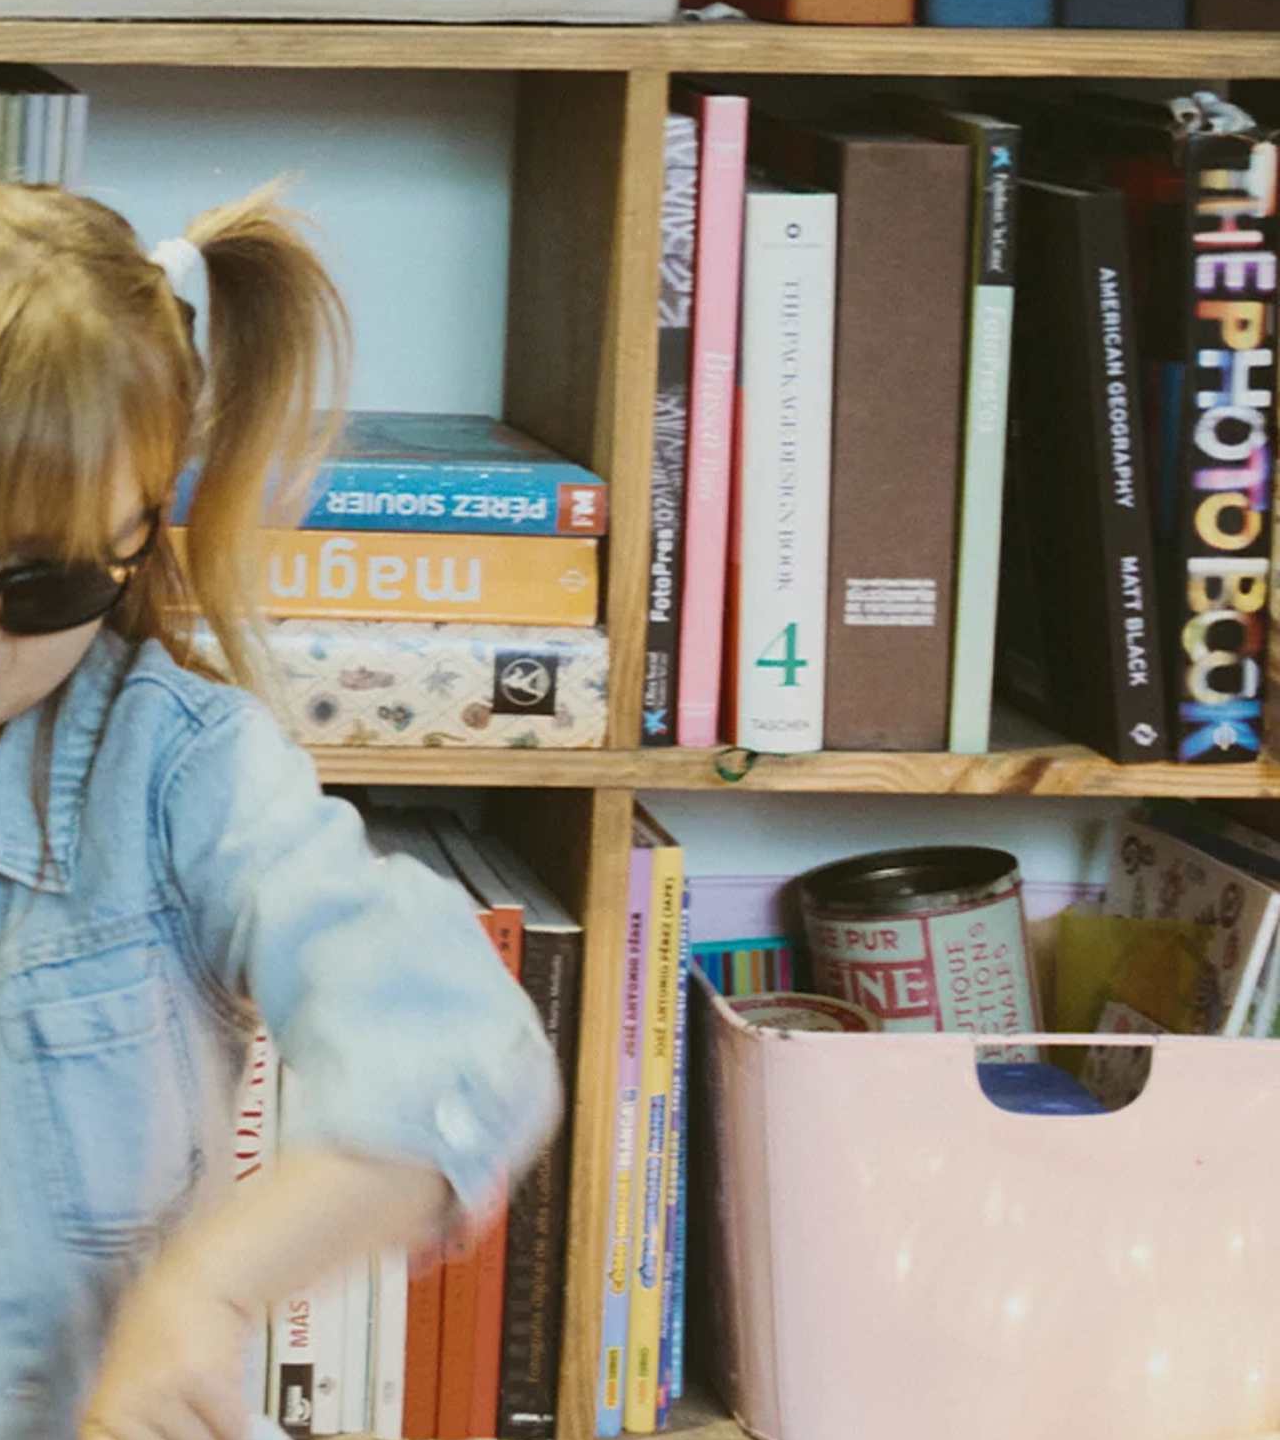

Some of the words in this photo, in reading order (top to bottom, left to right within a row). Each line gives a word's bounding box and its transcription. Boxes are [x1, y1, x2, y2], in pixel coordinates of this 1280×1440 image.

[1192, 141, 1278, 291] THE
[1097, 266, 1125, 377] AMERICAN
[1106, 379, 1135, 509] GEOGRAPHY
[326, 490, 447, 517] SIQUIER
[451, 492, 548, 522] PÉREZ
[779, 441, 797, 521] DESIGN
[268, 538, 482, 603] magn
[777, 529, 795, 591] BOOK
[1120, 555, 1143, 611] MATT
[755, 622, 808, 687] 4
[1125, 617, 1148, 687] BLACK
[656, 965, 670, 1022] ANTONIO
